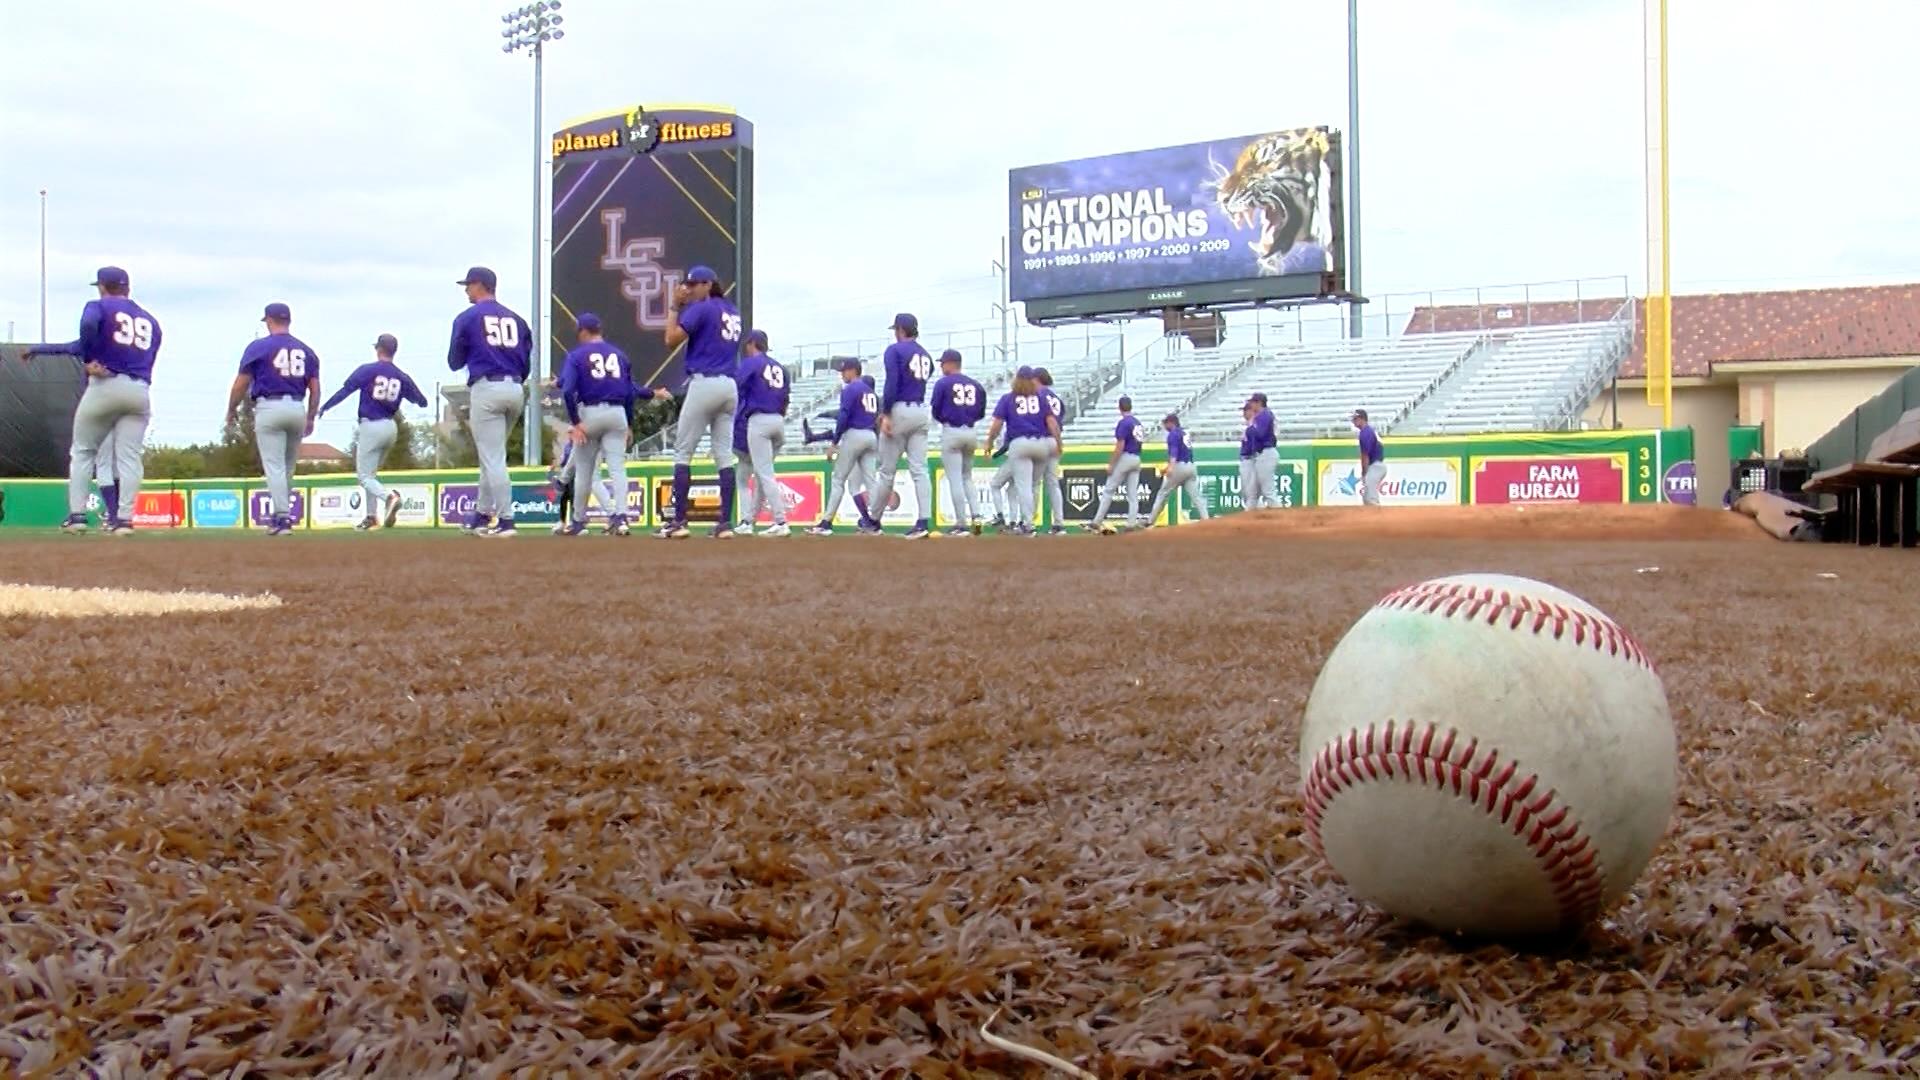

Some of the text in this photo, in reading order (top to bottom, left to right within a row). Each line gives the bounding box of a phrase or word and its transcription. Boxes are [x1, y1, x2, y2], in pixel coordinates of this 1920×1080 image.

[553, 130, 619, 156] planet
[661, 121, 733, 142] fitness
[1022, 187, 1172, 229] NATIONAL
[1022, 208, 1209, 254] CHAMPIONS
[602, 208, 684, 330] LSU
[1023, 257, 1047, 270] 1991
[1161, 243, 1190, 256] 2000
[1200, 239, 1230, 252] 2009
[112, 311, 154, 351] 39
[483, 315, 520, 349] 50
[272, 347, 307, 378] 46
[588, 352, 622, 380] 34
[762, 363, 785, 390] 43
[952, 383, 977, 407] 33
[1529, 465, 1580, 482] FARM
[1071, 485, 1090, 500] NTS
[1508, 483, 1580, 499] BUREAU
